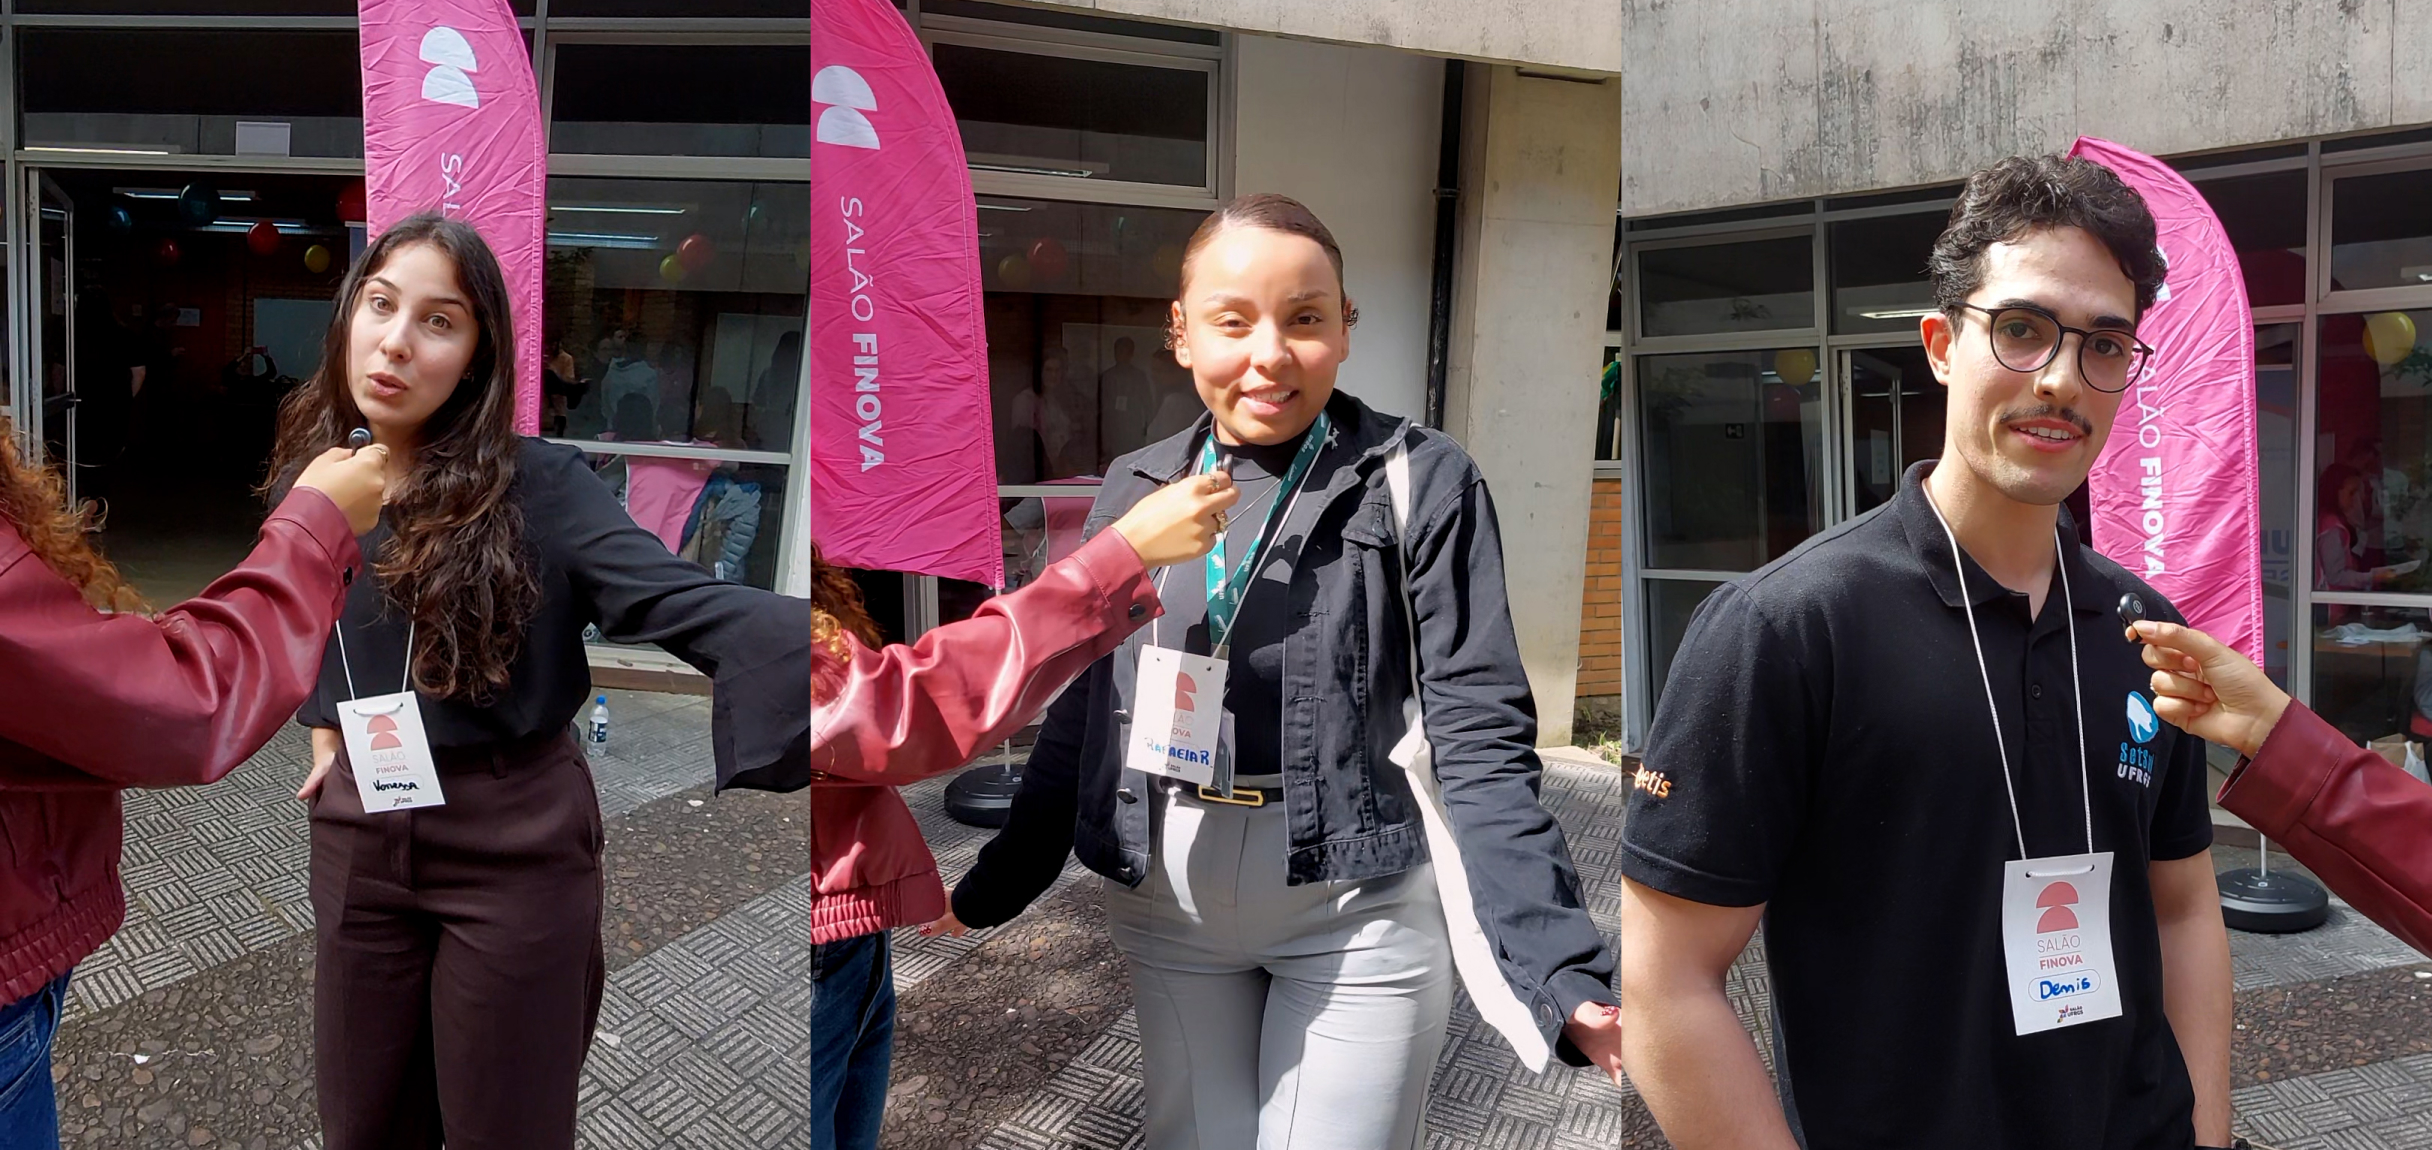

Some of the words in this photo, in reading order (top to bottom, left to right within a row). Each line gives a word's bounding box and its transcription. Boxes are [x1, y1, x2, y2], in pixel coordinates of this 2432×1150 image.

[441, 152, 462, 218] SAL
[840, 196, 874, 322] SALÃO
[852, 333, 885, 472] FINOVA
[2139, 457, 2166, 579] FINOVA
[1172, 727, 1191, 738] OVA
[376, 765, 409, 774] FINOVA
[2037, 934, 2081, 953] SALÃO
[2039, 955, 2083, 970] FINOVA
[2040, 978, 2091, 999] Denis
